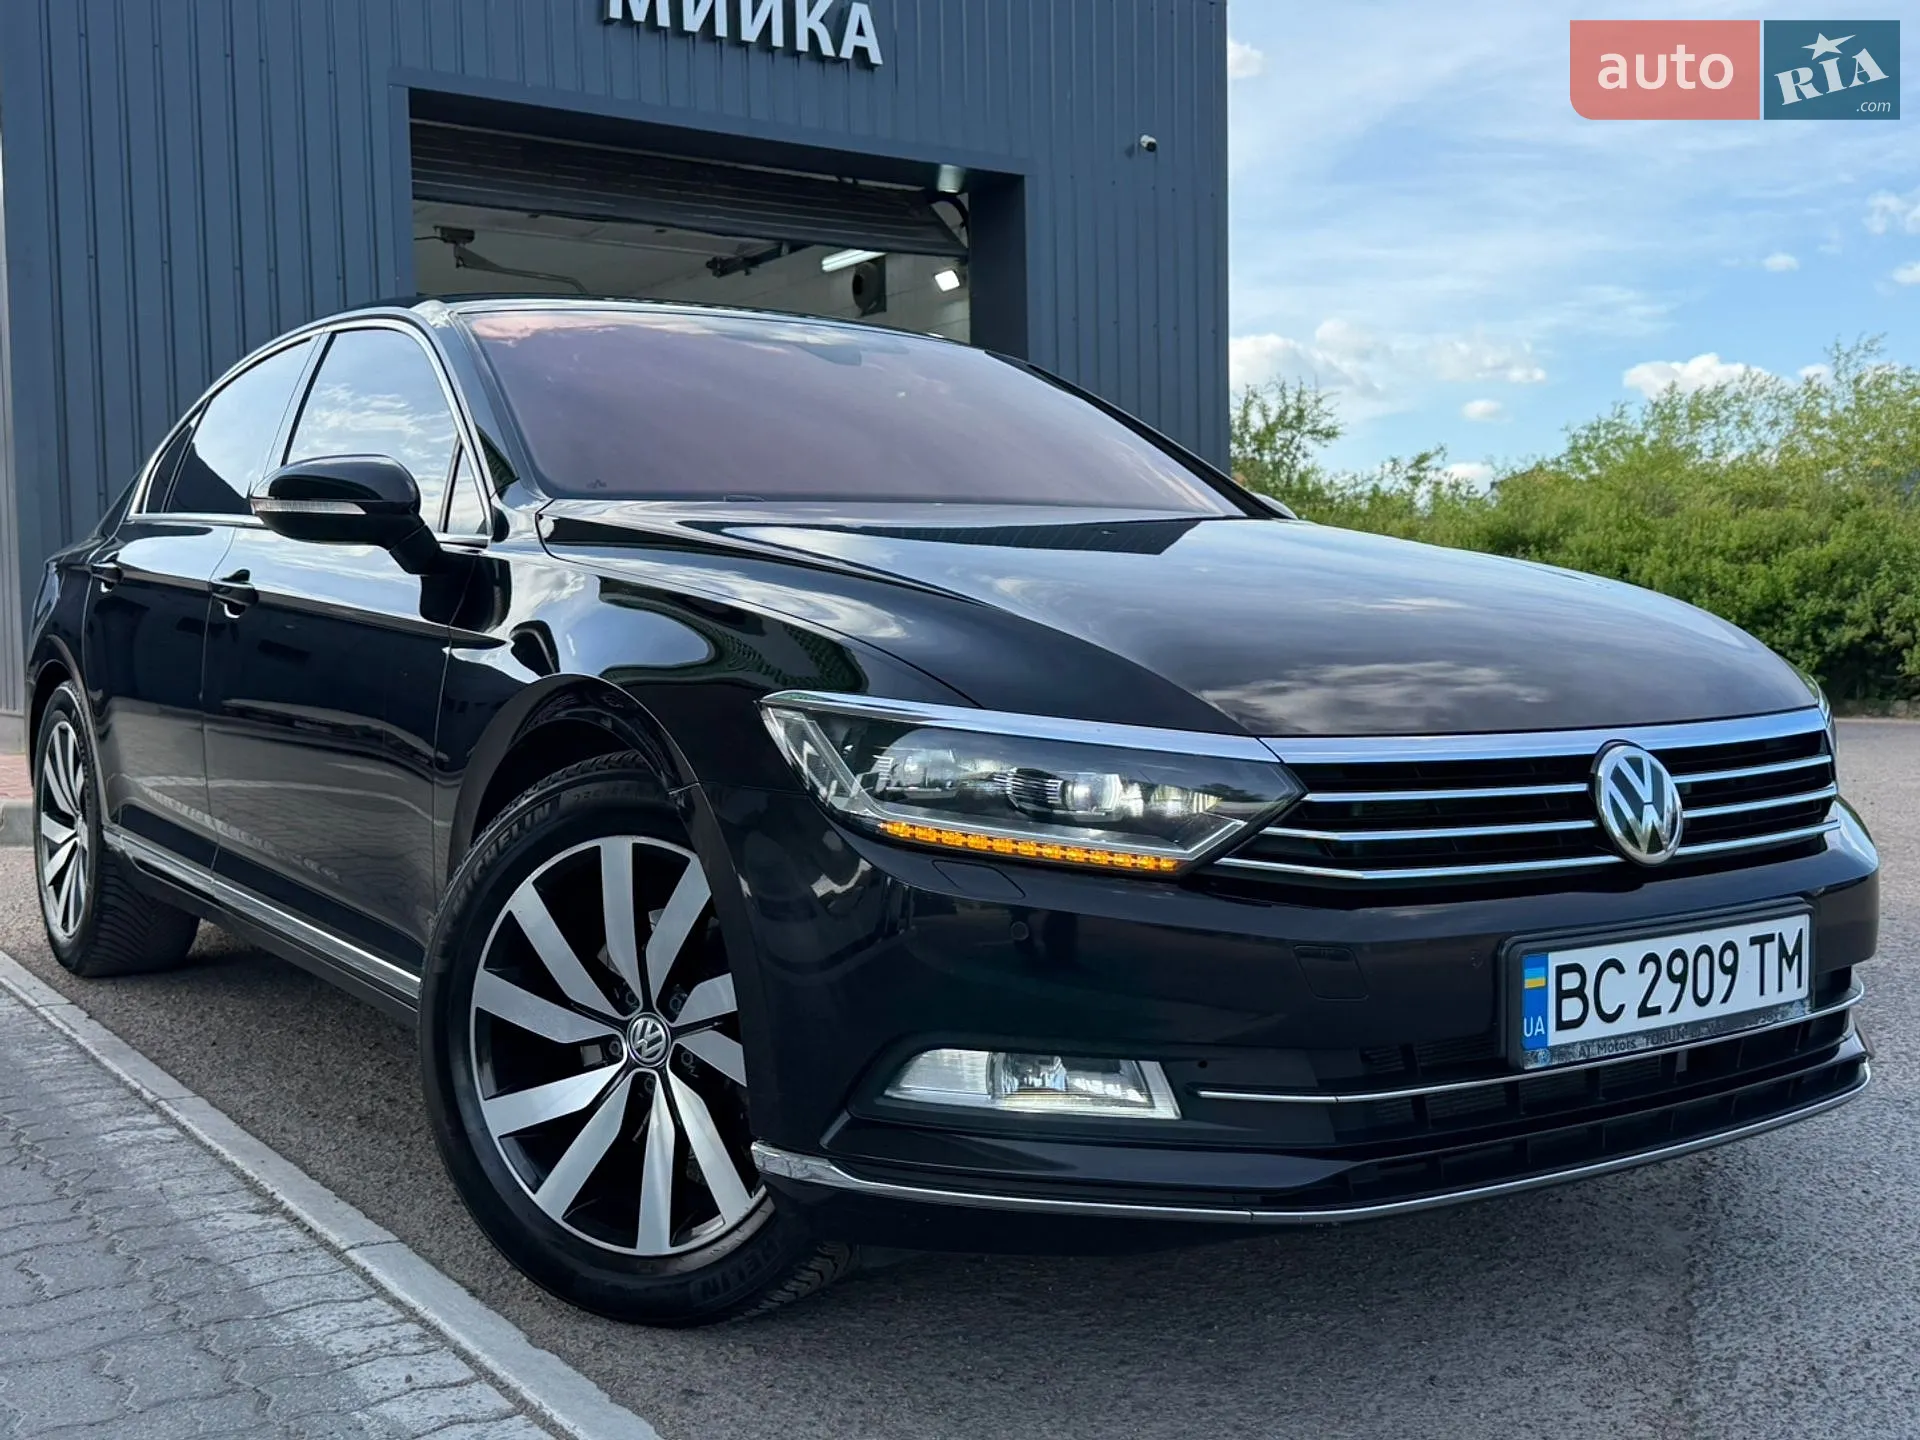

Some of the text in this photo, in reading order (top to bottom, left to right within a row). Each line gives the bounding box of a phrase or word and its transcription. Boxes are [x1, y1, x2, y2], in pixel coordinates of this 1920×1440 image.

[1555, 927, 1803, 1032] BC 2909 TM
[1523, 1016, 1546, 1038] UA
